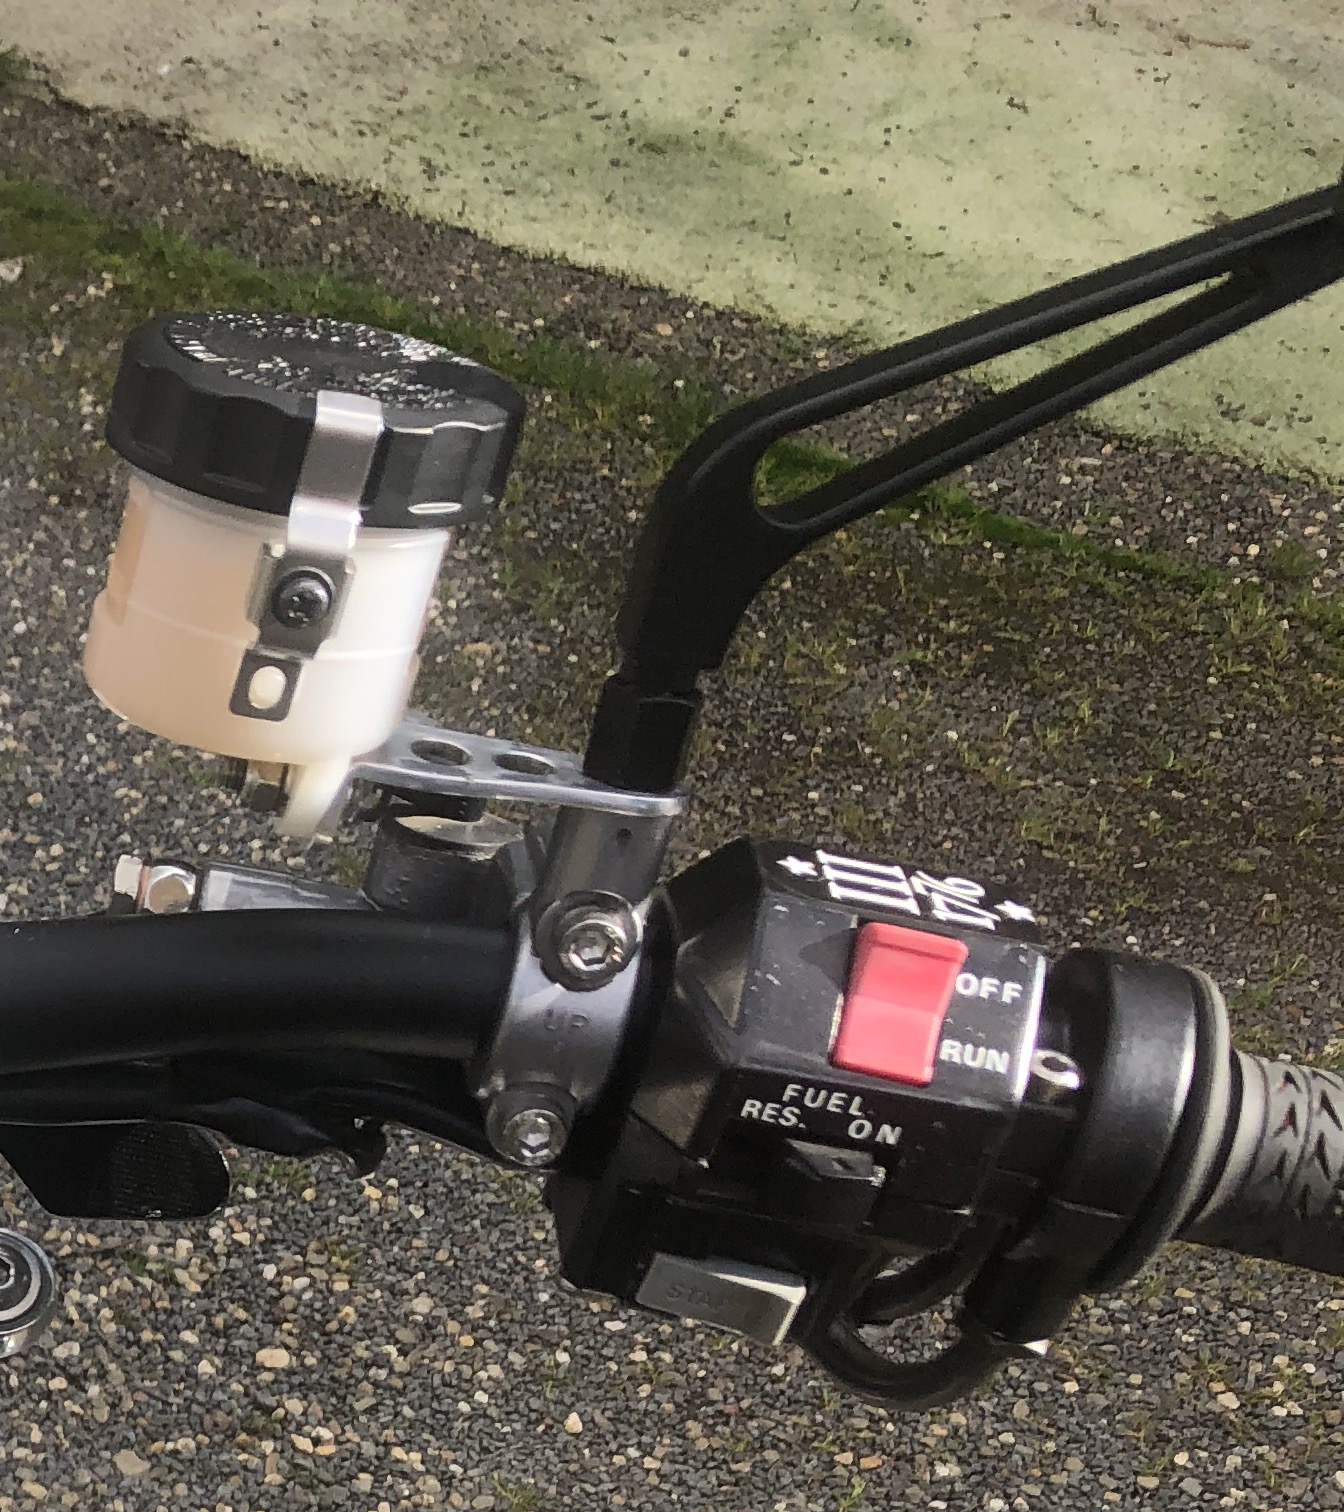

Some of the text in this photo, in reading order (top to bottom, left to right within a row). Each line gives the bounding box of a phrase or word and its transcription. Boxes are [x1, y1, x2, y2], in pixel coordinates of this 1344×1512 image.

[955, 972, 1024, 1005] OFF
[939, 1038, 1010, 1075] RUN
[782, 1083, 866, 1116] FUEL
[740, 1098, 903, 1145] RES. ON
